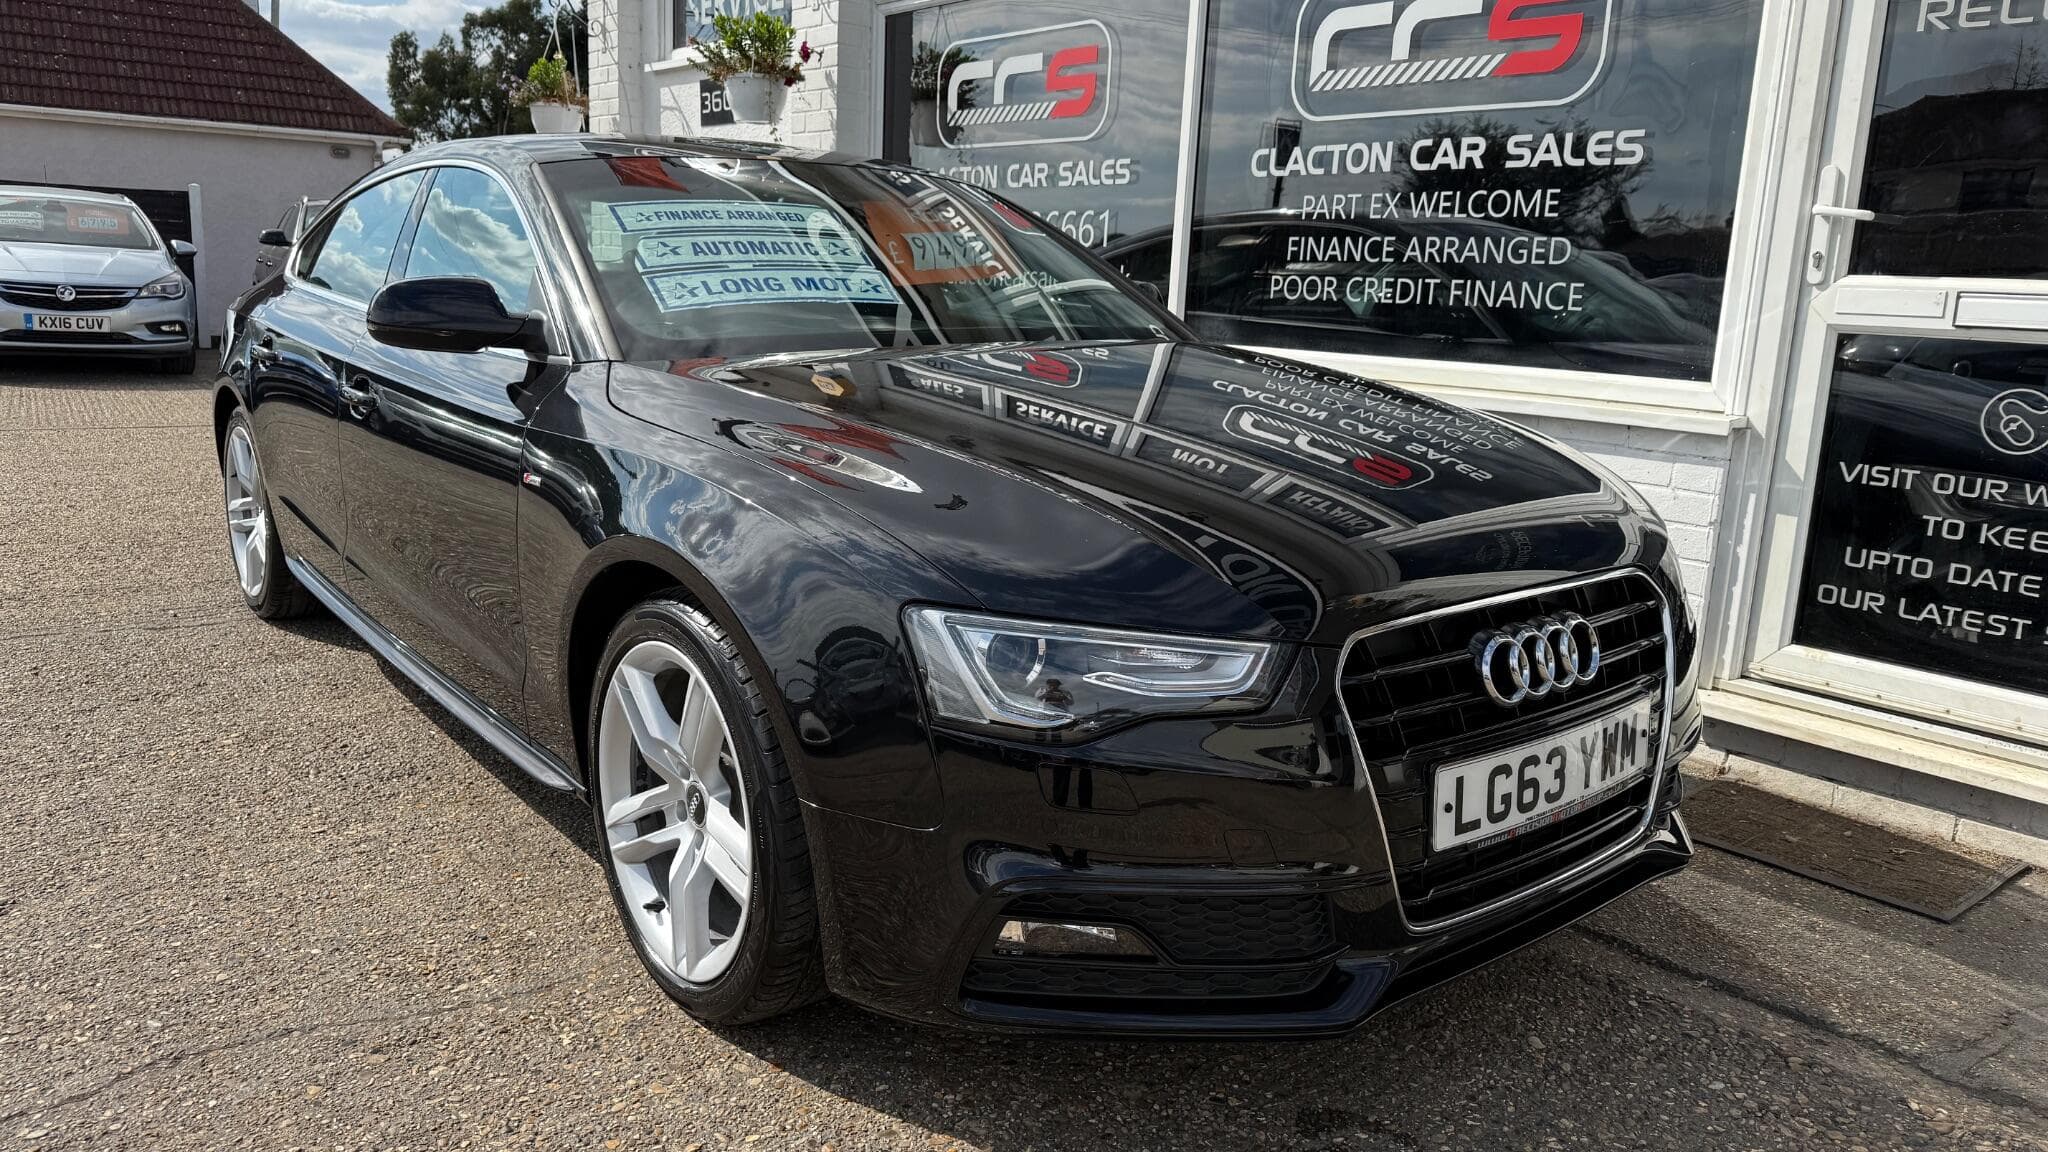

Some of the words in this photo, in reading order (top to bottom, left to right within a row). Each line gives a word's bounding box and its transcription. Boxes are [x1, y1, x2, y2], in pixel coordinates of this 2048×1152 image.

[1251, 141, 1393, 177] CLACTON
[1410, 137, 1486, 170] CAR
[1505, 129, 1646, 168] SALES
[1007, 163, 1048, 188] CAR
[1058, 158, 1131, 187] SALES
[655, 210, 723, 221] FINANCE
[727, 210, 806, 222] ARRANGED
[1301, 194, 1361, 220] PART
[1369, 192, 1401, 219] EX
[1410, 189, 1561, 218] WELCOME
[690, 240, 820, 257] AUTOMATIC
[1287, 236, 1396, 262] FINANCE
[1403, 237, 1572, 265] ARRANGED
[701, 277, 786, 296] LONG
[791, 276, 852, 293] MOT
[1270, 275, 1338, 301] POOR
[1346, 277, 1441, 305] CREDIT
[1449, 280, 1585, 311] FINANCE
[38, 316, 72, 330] KX16
[76, 317, 104, 330] CUV
[1839, 461, 1920, 490] VISIT
[1932, 473, 2008, 501] OUR
[1922, 514, 1965, 541] TO
[1844, 546, 1933, 579] UPTO
[1947, 563, 2043, 598] DATE
[1817, 584, 1885, 614] OUR
[1899, 598, 2032, 640] LATEST
[1454, 745, 1567, 837] LG63
[1580, 712, 1638, 790] YWM
